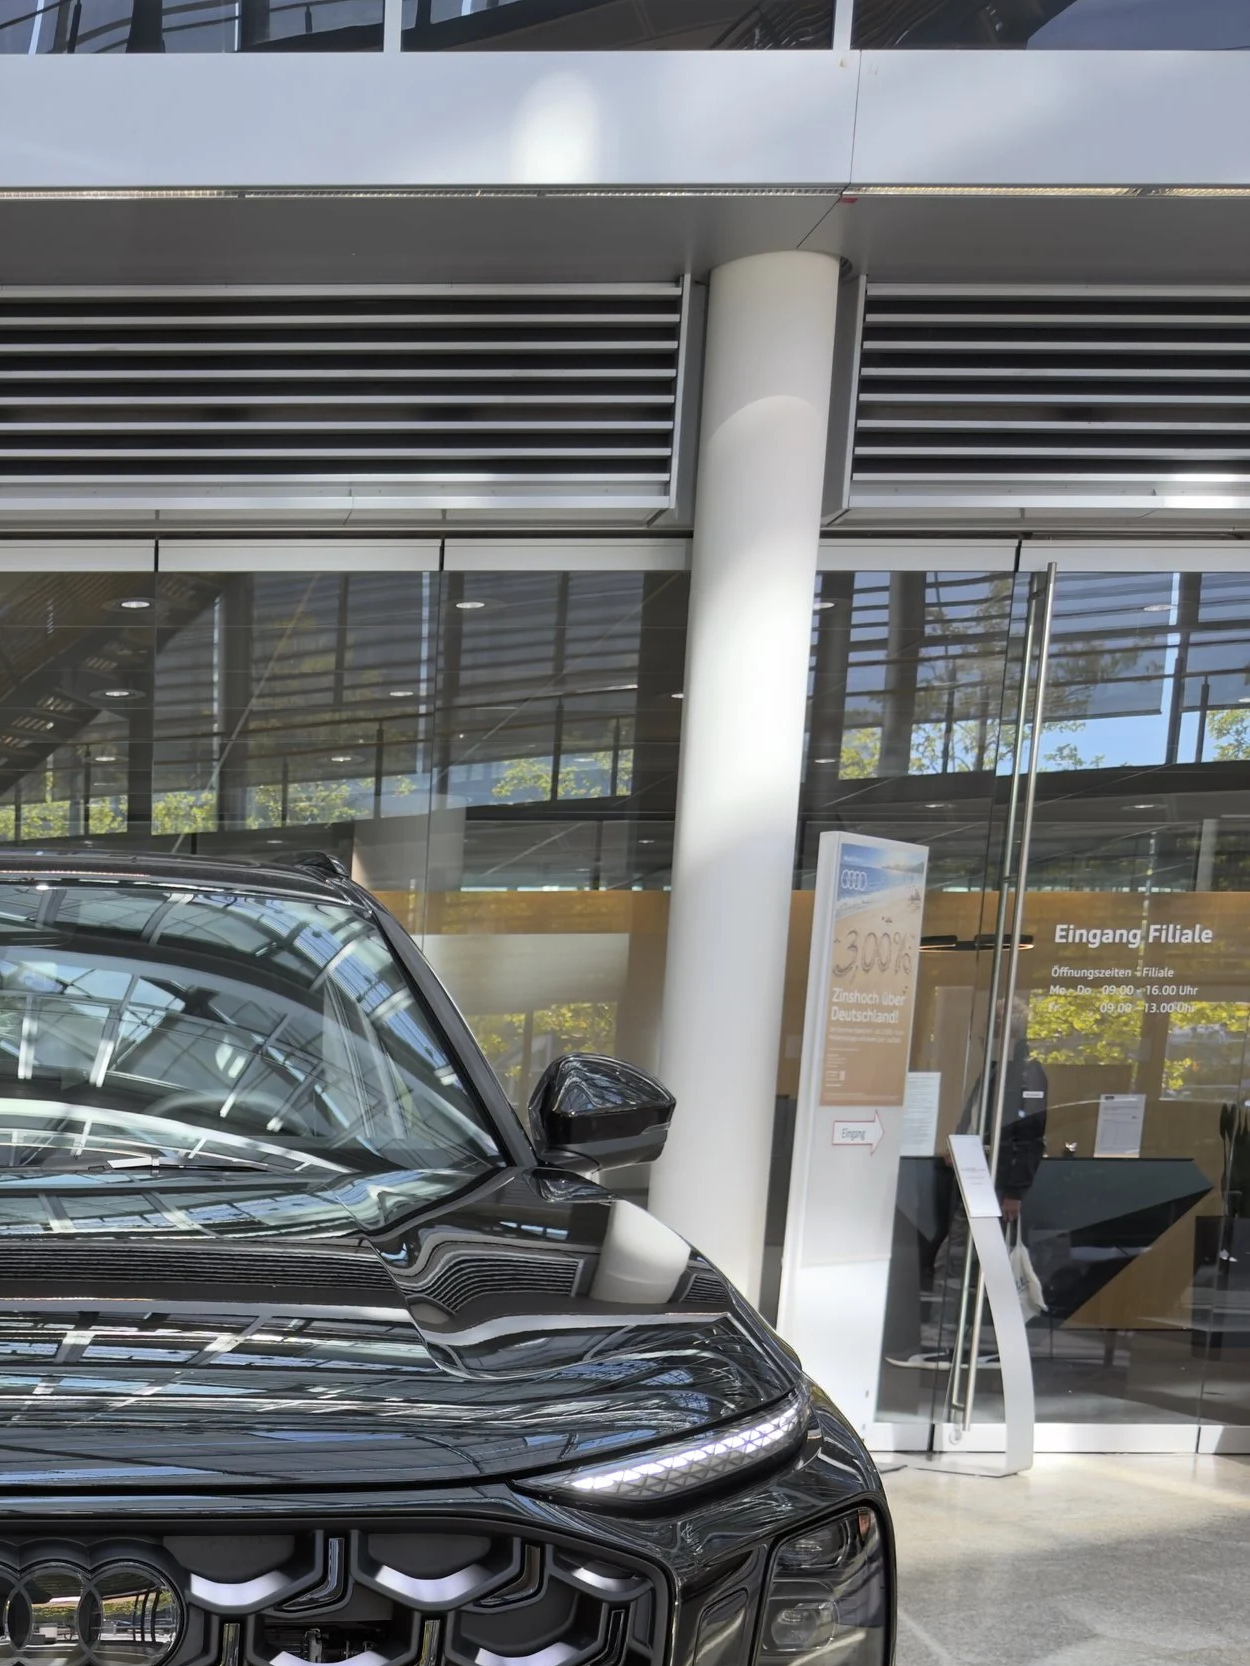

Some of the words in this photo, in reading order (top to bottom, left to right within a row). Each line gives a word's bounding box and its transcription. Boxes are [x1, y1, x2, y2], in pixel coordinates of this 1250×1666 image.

[1054, 924, 1142, 948] Eingang
[1148, 924, 1213, 943] Filiale
[832, 929, 912, 983] 3,00%
[1051, 965, 1132, 980] Öffnungszeiten
[1142, 967, 1174, 978] Filiale
[832, 987, 880, 1005] Zinshoch
[881, 990, 906, 1007] über
[1050, 985, 1065, 995] Mo
[1076, 986, 1091, 995] Do
[1101, 985, 1134, 996] 09.00
[1145, 985, 1176, 996] 16.00
[1179, 985, 1199, 996] Uhr
[830, 1006, 899, 1024] Deutschland!
[1100, 1003, 1132, 1013] 09.00
[1143, 1003, 1175, 1013] 13.00
[1177, 1002, 1196, 1013] Uhr
[841, 1127, 867, 1141] Eingang
